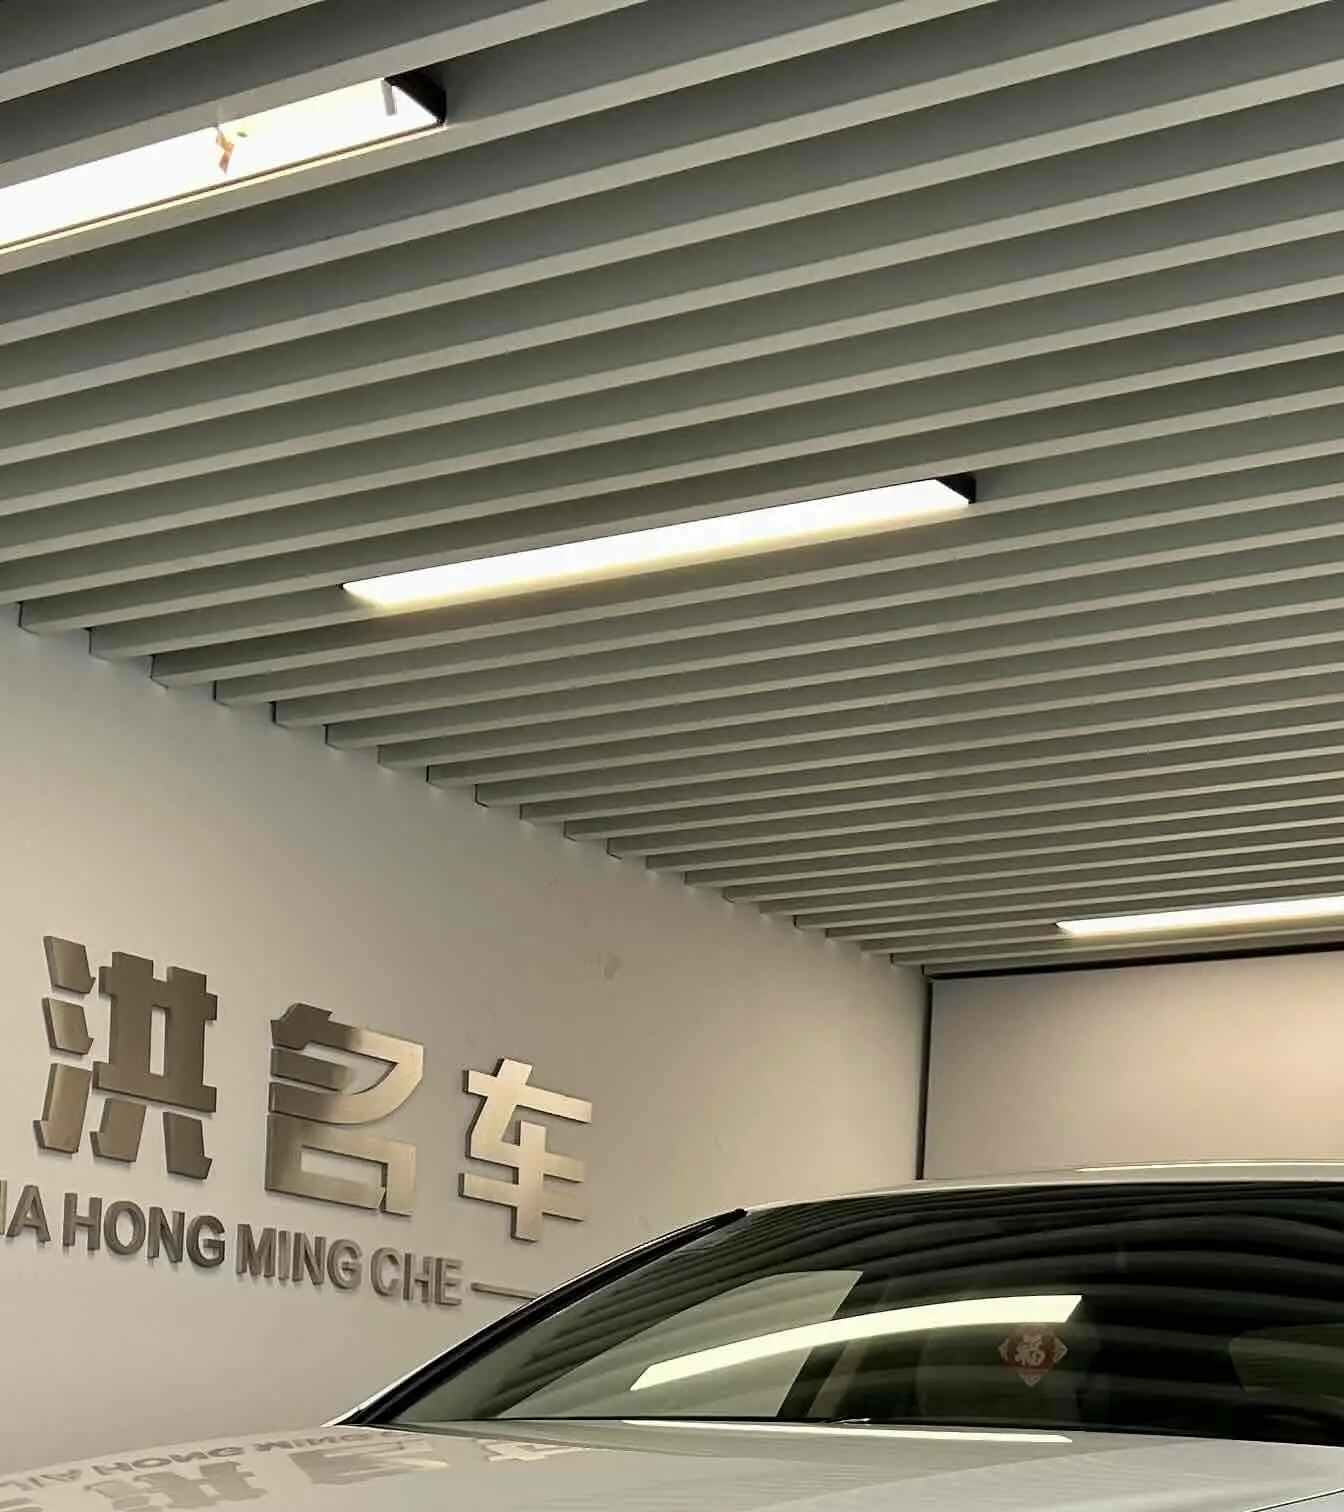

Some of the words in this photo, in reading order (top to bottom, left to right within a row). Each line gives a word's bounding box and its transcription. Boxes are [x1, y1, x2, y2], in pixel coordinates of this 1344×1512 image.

[62, 1192, 225, 1268] HONG
[236, 1223, 362, 1290] MING
[370, 1247, 464, 1306] CHE
